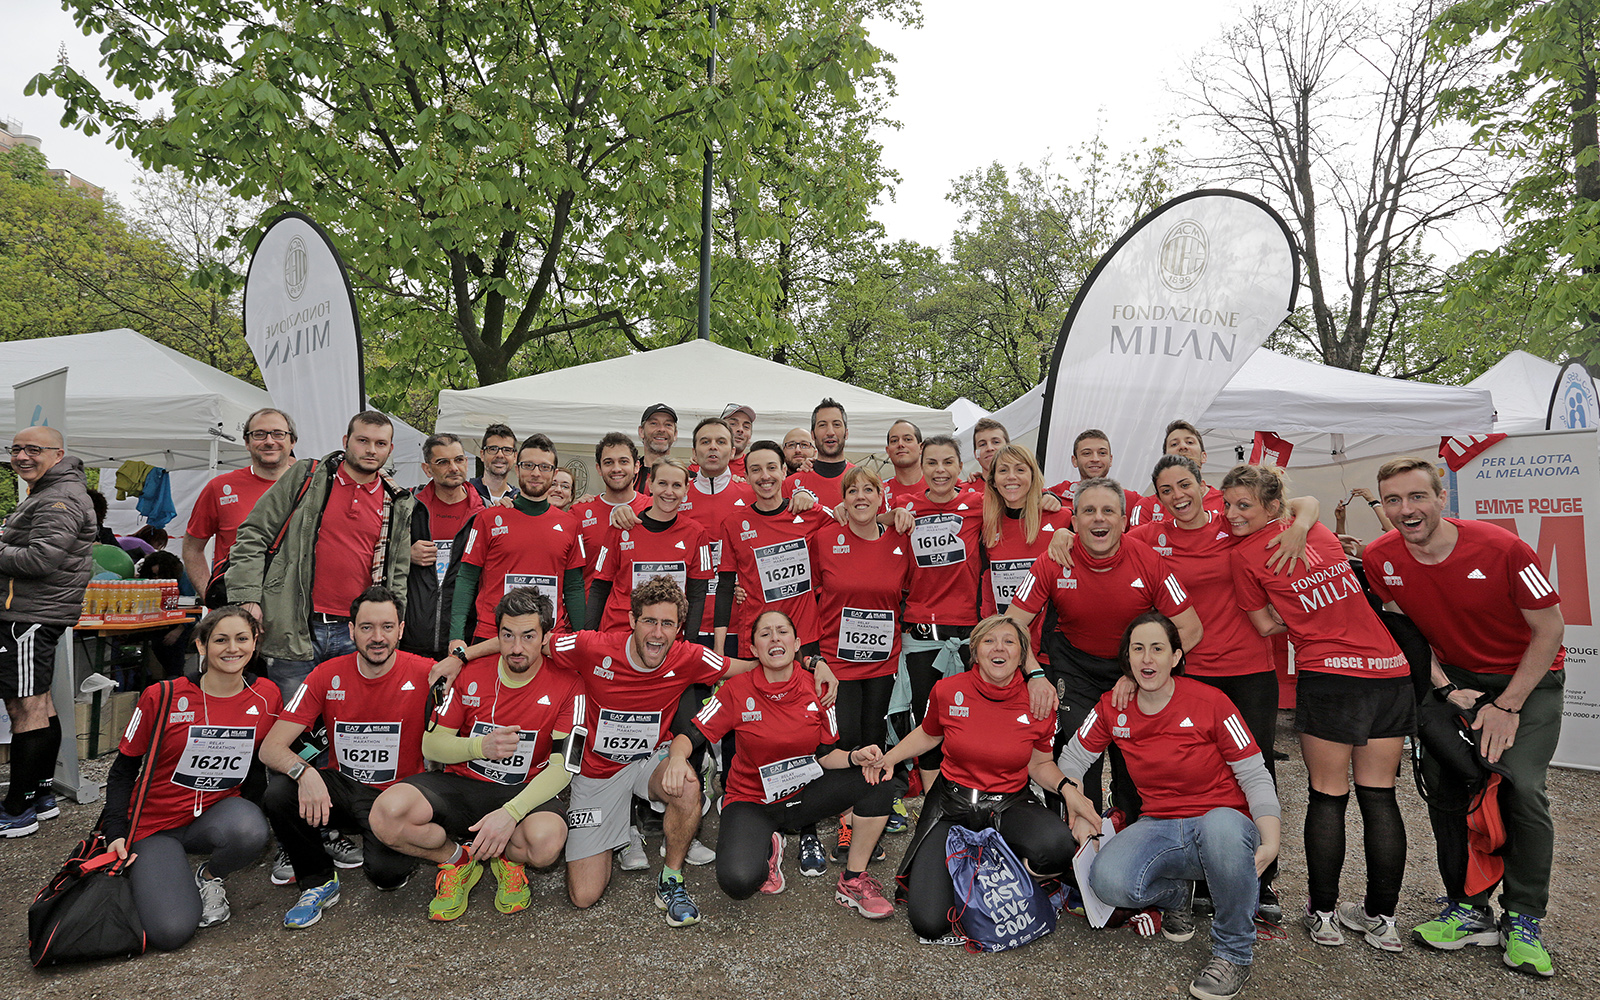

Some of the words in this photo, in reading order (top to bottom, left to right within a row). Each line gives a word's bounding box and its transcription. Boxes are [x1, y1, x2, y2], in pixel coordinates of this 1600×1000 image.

[1173, 225, 1200, 238] ACM
[1168, 275, 1191, 284] 1899
[1112, 304, 1240, 328] FONDAZIONE
[1110, 325, 1237, 362] MILAN
[1482, 457, 1506, 467] PER
[1510, 456, 1526, 466] LA
[1530, 453, 1573, 465] LOTTA
[1475, 469, 1492, 479] AL
[1495, 465, 1580, 478] MELANOMA
[1475, 498, 1524, 515] EMME
[1529, 497, 1583, 514] ROUGE
[917, 533, 957, 549] 1616A
[930, 553, 949, 563] EA7
[765, 563, 806, 582] 1627B
[780, 584, 798, 595] EA7
[997, 585, 1016, 598] 163
[845, 631, 888, 646] 1628C
[1324, 656, 1363, 669] COSCE
[603, 737, 649, 749] 1637A
[190, 755, 242, 770] 1621C
[342, 748, 389, 763] 1621B
[352, 769, 375, 779] EA7
[484, 768, 507, 780] EA7
[194, 777, 222, 787] EA7
[977, 863, 1014, 889] RUN
[983, 880, 1023, 909] FAST
[990, 898, 1030, 924] LIVE
[995, 912, 1036, 938] COOL
